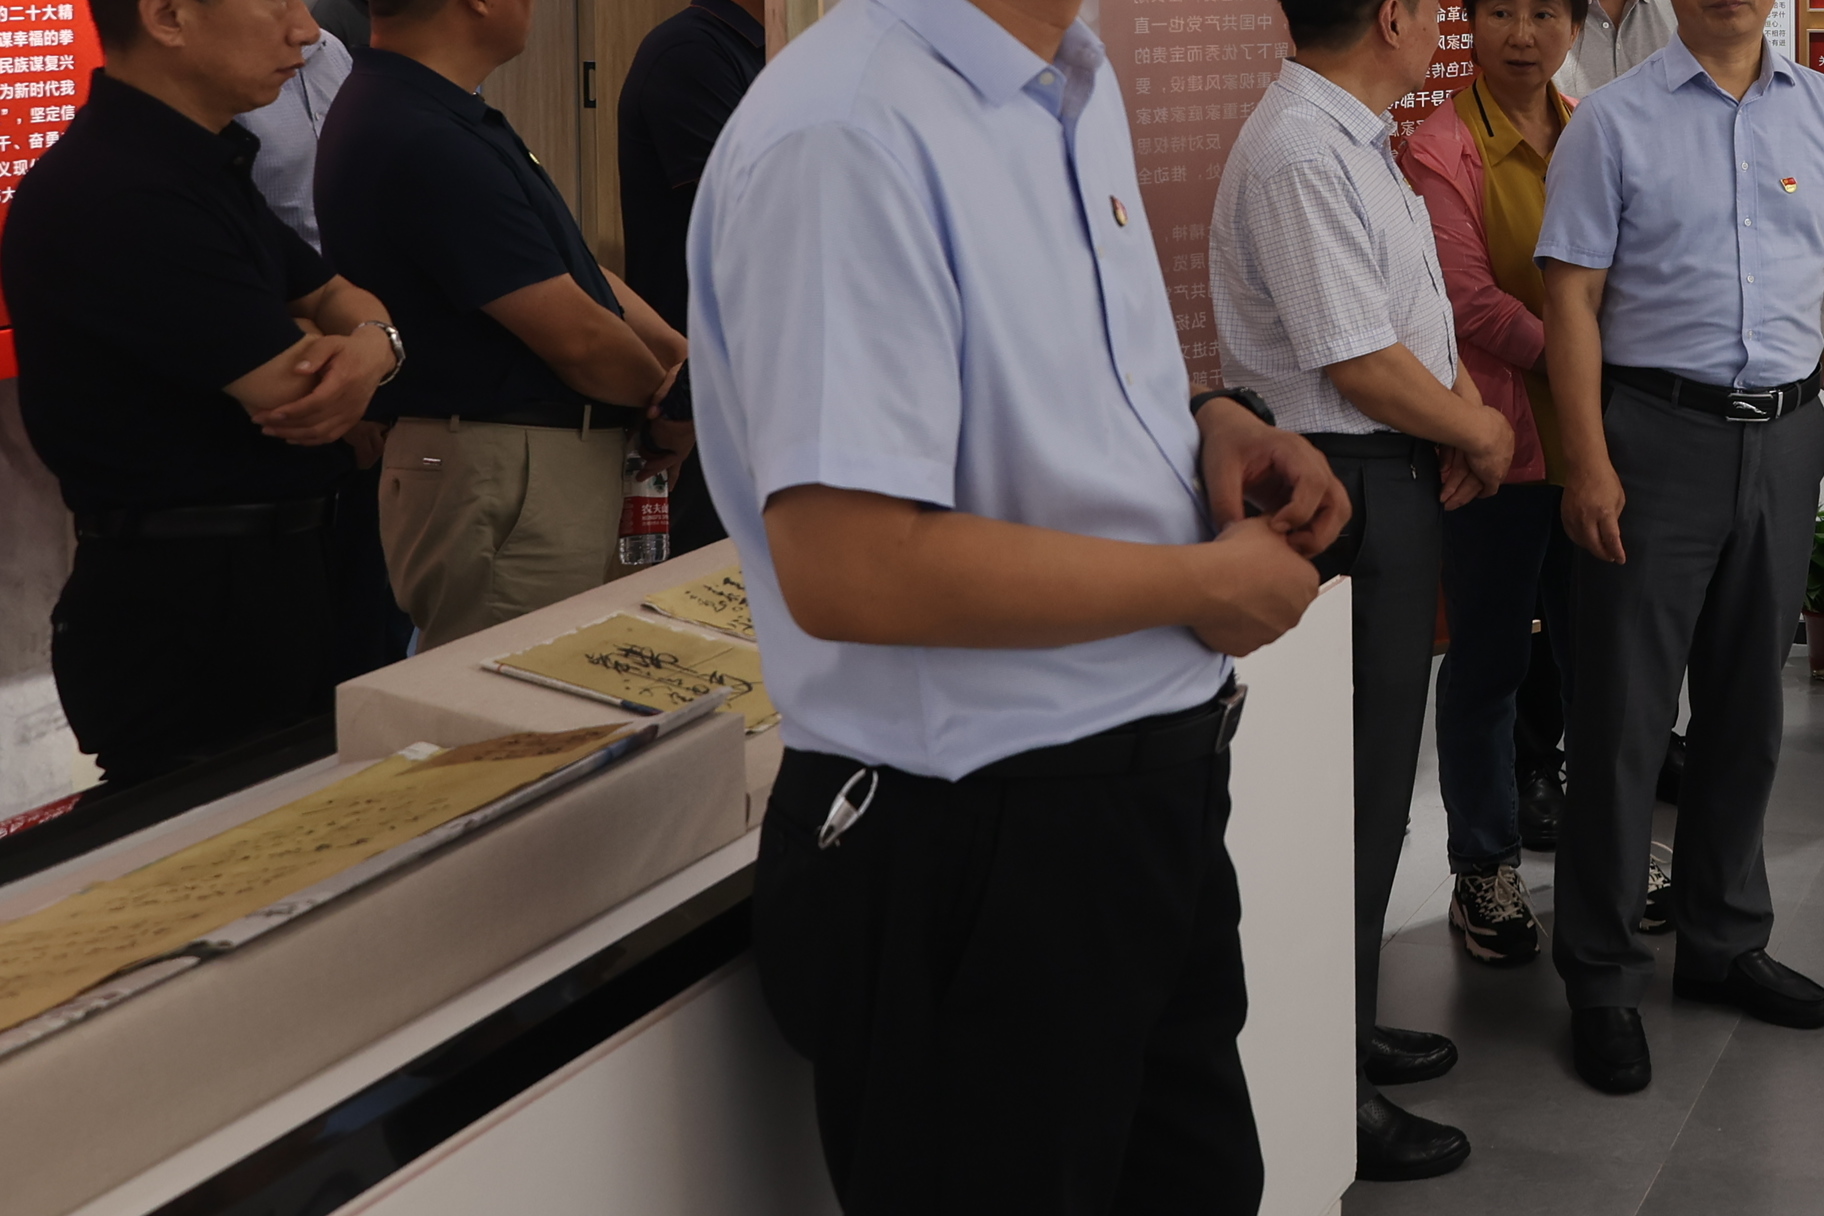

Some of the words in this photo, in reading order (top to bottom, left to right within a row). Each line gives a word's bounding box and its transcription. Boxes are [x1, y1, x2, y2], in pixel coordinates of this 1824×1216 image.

[1767, 39, 1787, 47] 有进
[0, 54, 75, 74] 民族谋复兴
